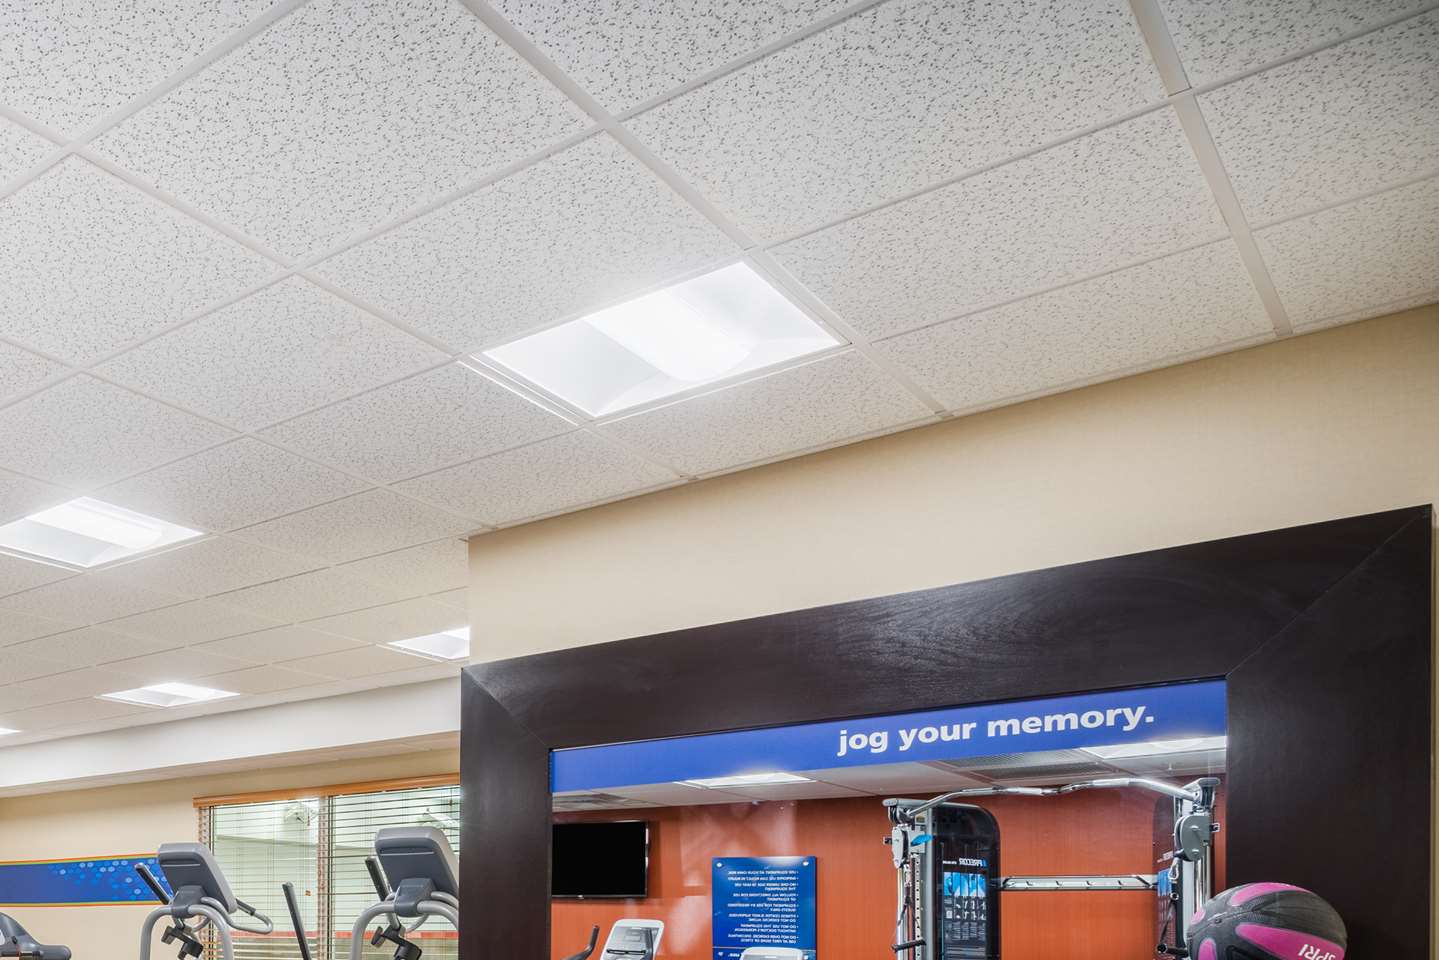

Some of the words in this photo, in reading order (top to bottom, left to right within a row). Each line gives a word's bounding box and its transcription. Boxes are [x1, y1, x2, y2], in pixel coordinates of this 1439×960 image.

[837, 730, 888, 756] jog
[898, 721, 977, 751] your
[987, 705, 1154, 737] memory.
